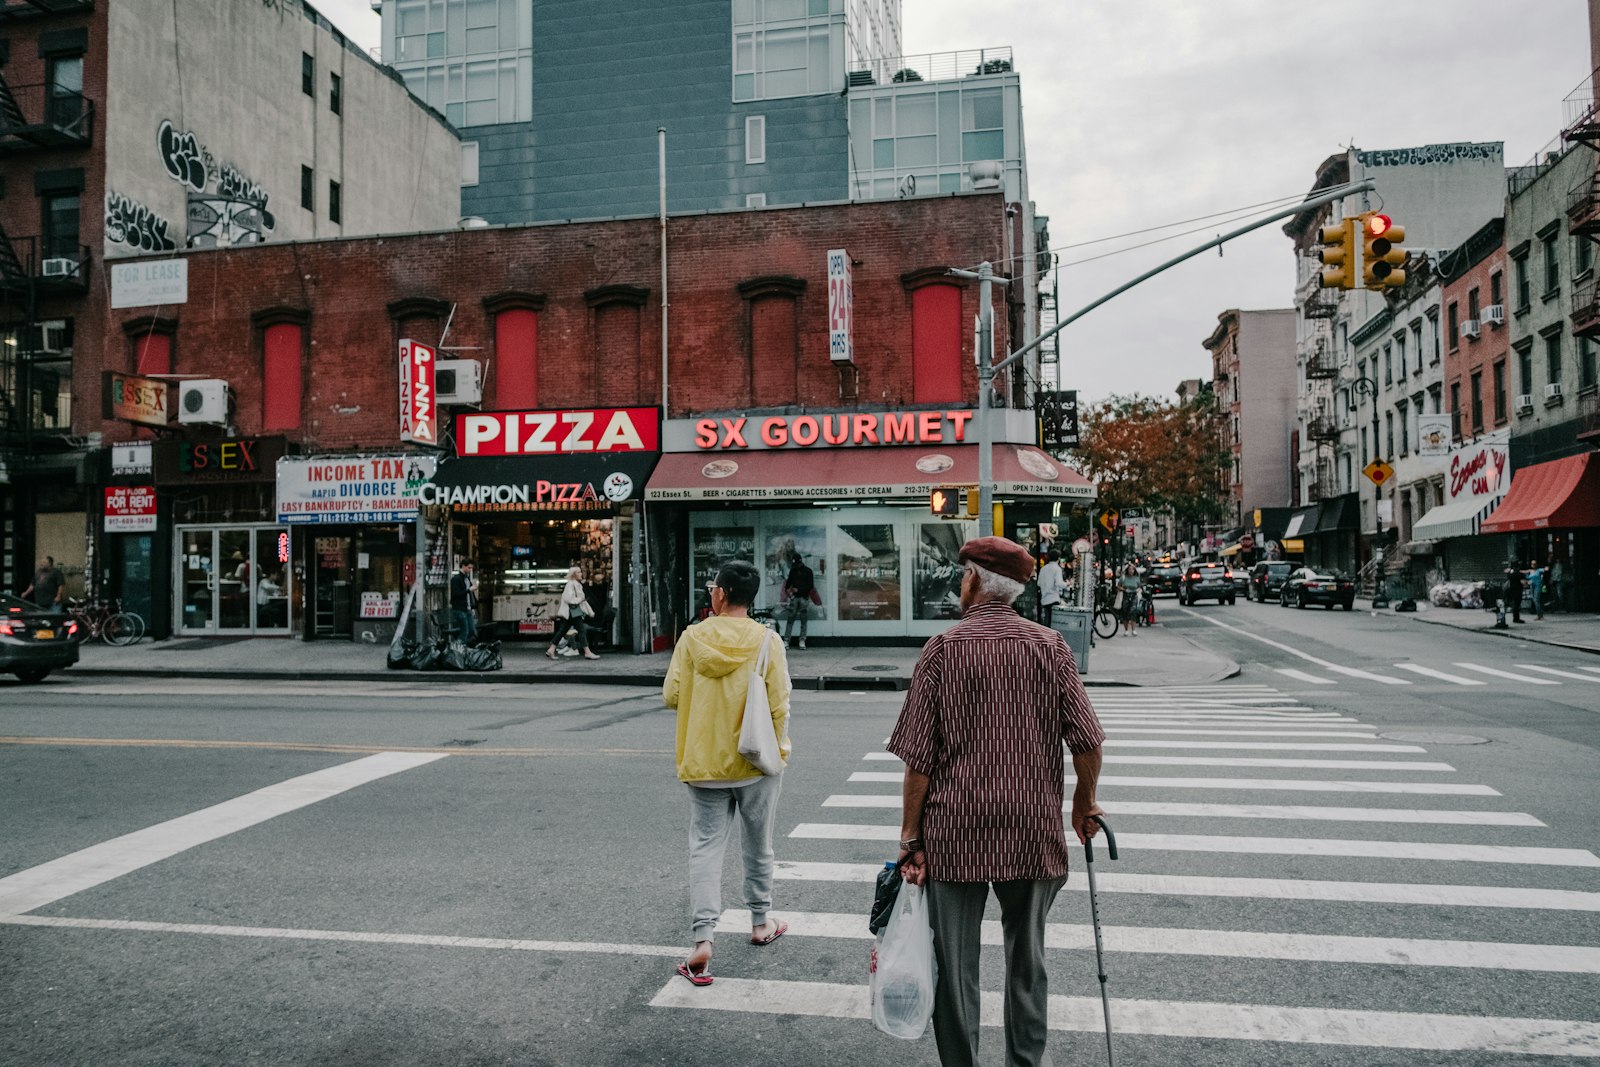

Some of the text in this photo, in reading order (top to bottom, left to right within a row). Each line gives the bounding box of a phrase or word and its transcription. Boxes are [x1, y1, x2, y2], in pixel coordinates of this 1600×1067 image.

[118, 264, 180, 283] FOR LEASE
[831, 279, 845, 330] 24
[832, 333, 845, 353] HRS
[114, 378, 164, 412] ESSEX
[400, 347, 410, 433] PIZZA
[414, 346, 432, 440] PIZZA
[465, 410, 645, 454] PIZZA
[694, 410, 973, 448] SX GOURMET
[178, 441, 255, 472] ESSEX
[308, 460, 404, 482] INCOME TAX
[106, 495, 154, 508] FOR RENT
[312, 489, 336, 498] RAPID
[340, 482, 396, 497] DIVORCE
[418, 482, 529, 505] CHAMPION
[282, 499, 419, 512] EASY BANKRUPTCY BANCARRO
[280, 533, 288, 562] OPEN
[365, 608, 392, 616] FOR RENT
